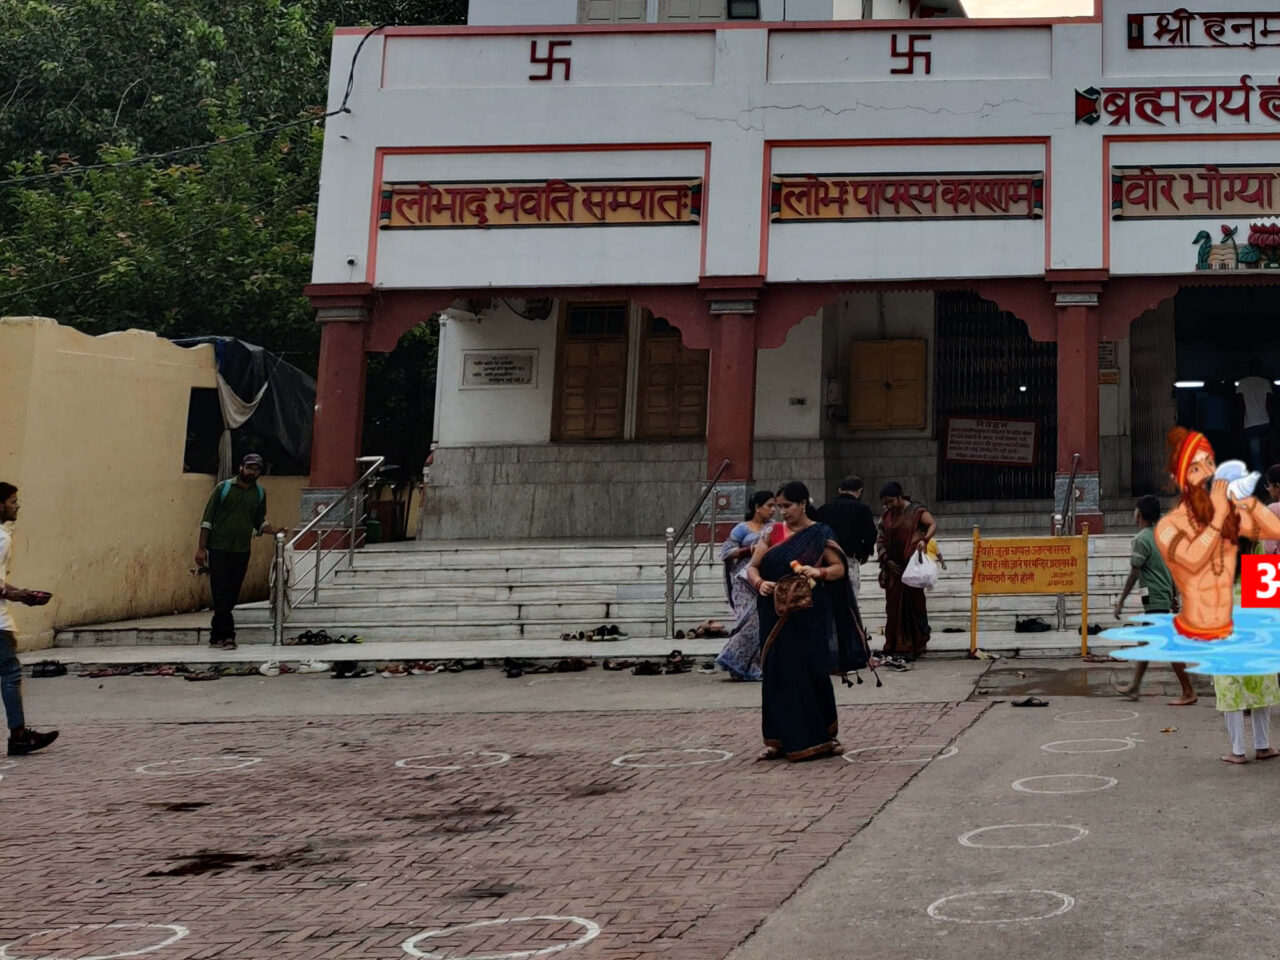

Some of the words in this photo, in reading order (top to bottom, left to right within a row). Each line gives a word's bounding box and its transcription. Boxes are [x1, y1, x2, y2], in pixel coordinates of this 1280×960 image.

[1153, 8, 1197, 44] श्री
[1100, 74, 1253, 126] ब्रह्मचर्य
[494, 178, 578, 221] भवति
[850, 179, 939, 214] पापस्य
[1122, 167, 1180, 211] वीर
[1180, 165, 1277, 211] भोग्या
